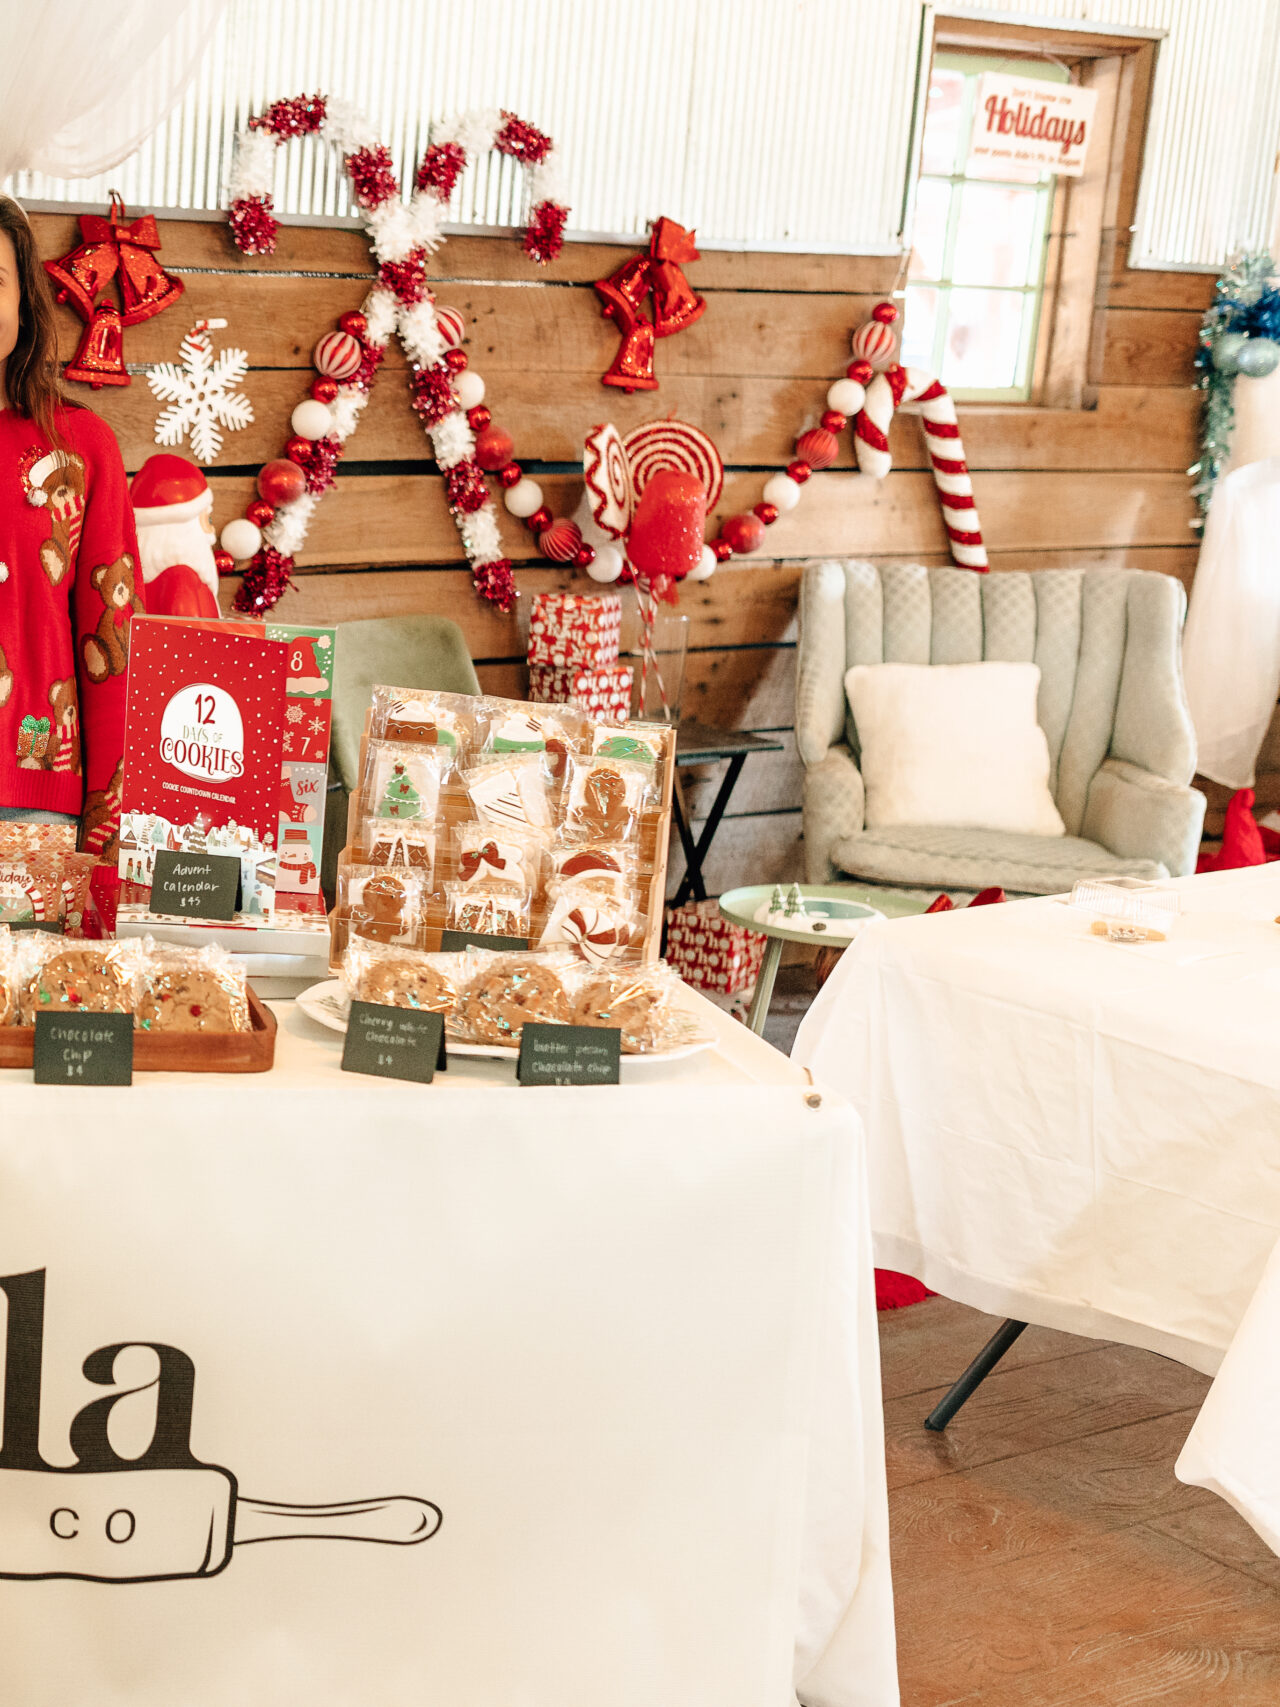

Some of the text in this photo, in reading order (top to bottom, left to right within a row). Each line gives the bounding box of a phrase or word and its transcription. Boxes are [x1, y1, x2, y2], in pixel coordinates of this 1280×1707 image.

[985, 94, 1086, 154] Holidays
[290, 651, 303, 672] 8
[195, 693, 216, 725] 12
[183, 725, 209, 743] DAYS
[300, 736, 311, 756] 7
[161, 737, 242, 776] COOKIES
[162, 781, 237, 805] COOKIE COUNTDOWN CALENDAR
[173, 863, 212, 876] Advent
[163, 881, 220, 893] Calendar
[180, 896, 201, 908] $45
[50, 1027, 114, 1043] Chocolate
[49, 1507, 136, 1544] CO
